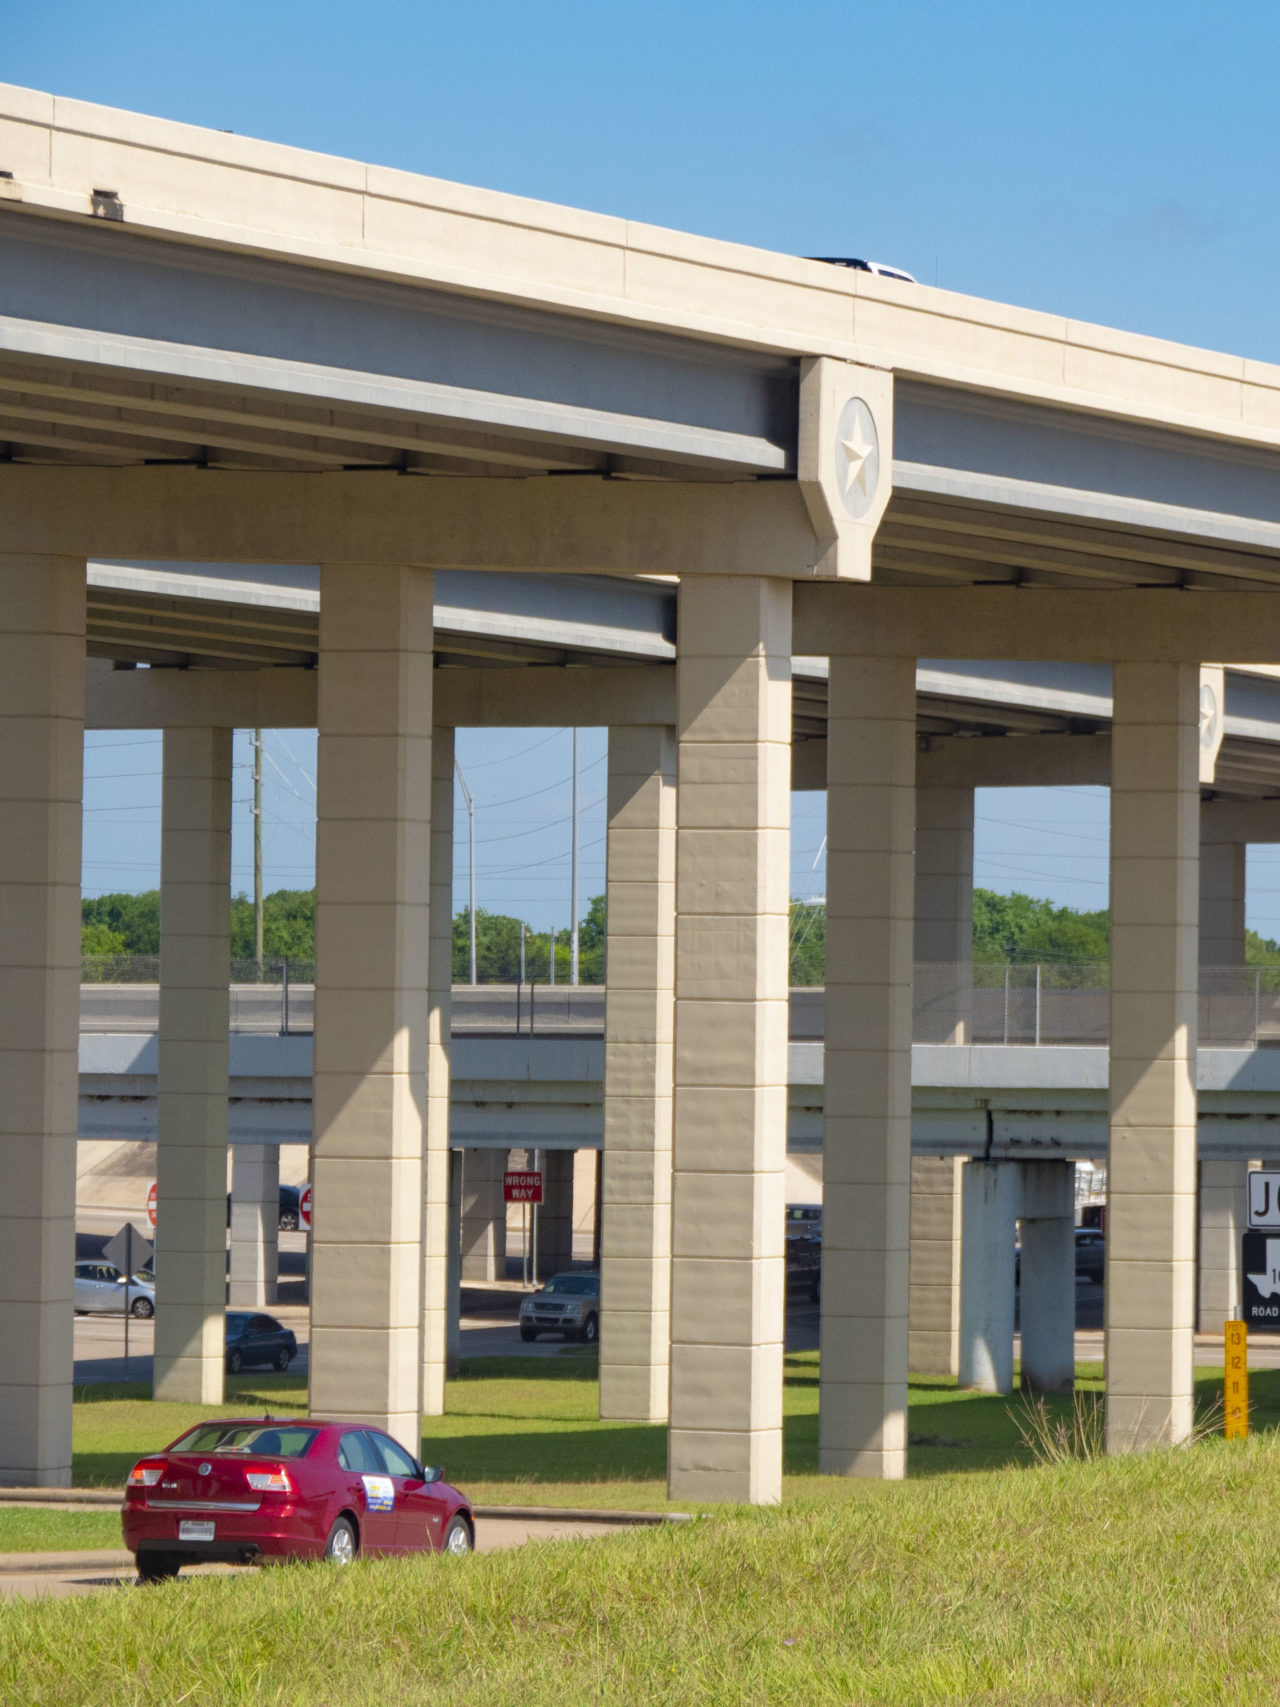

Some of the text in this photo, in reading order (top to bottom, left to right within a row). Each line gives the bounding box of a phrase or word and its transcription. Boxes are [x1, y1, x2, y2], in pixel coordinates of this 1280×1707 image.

[505, 1176, 540, 1186] WRONG
[512, 1188, 533, 1198] WAY
[1251, 1306, 1279, 1317] ROAD
[1231, 1332, 1241, 1346] 13
[1231, 1356, 1241, 1369] 12
[1232, 1381, 1239, 1394] 11
